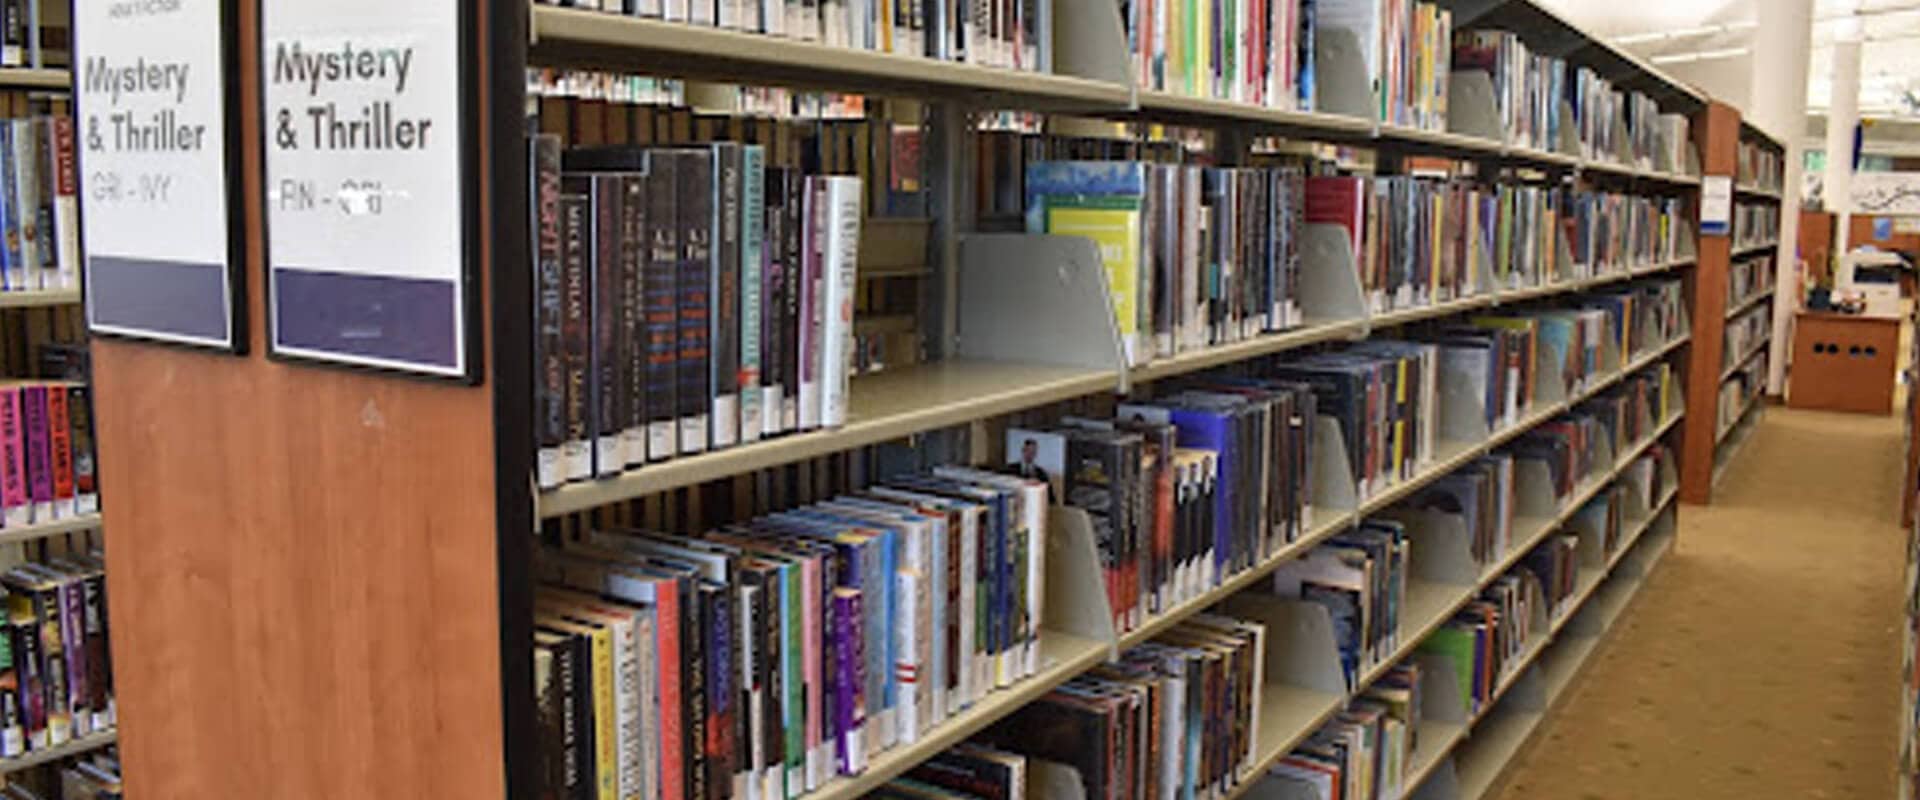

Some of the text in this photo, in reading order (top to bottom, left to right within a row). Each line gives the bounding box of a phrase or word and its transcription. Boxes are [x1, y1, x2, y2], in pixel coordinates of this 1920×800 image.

[85, 56, 189, 105] Mystery
[274, 41, 413, 96] Mystery
[87, 116, 105, 152] &
[110, 109, 206, 151] Thriller
[276, 101, 432, 150] & Thriller
[567, 204, 581, 250] MICK
[542, 259, 560, 334] SHIFT
